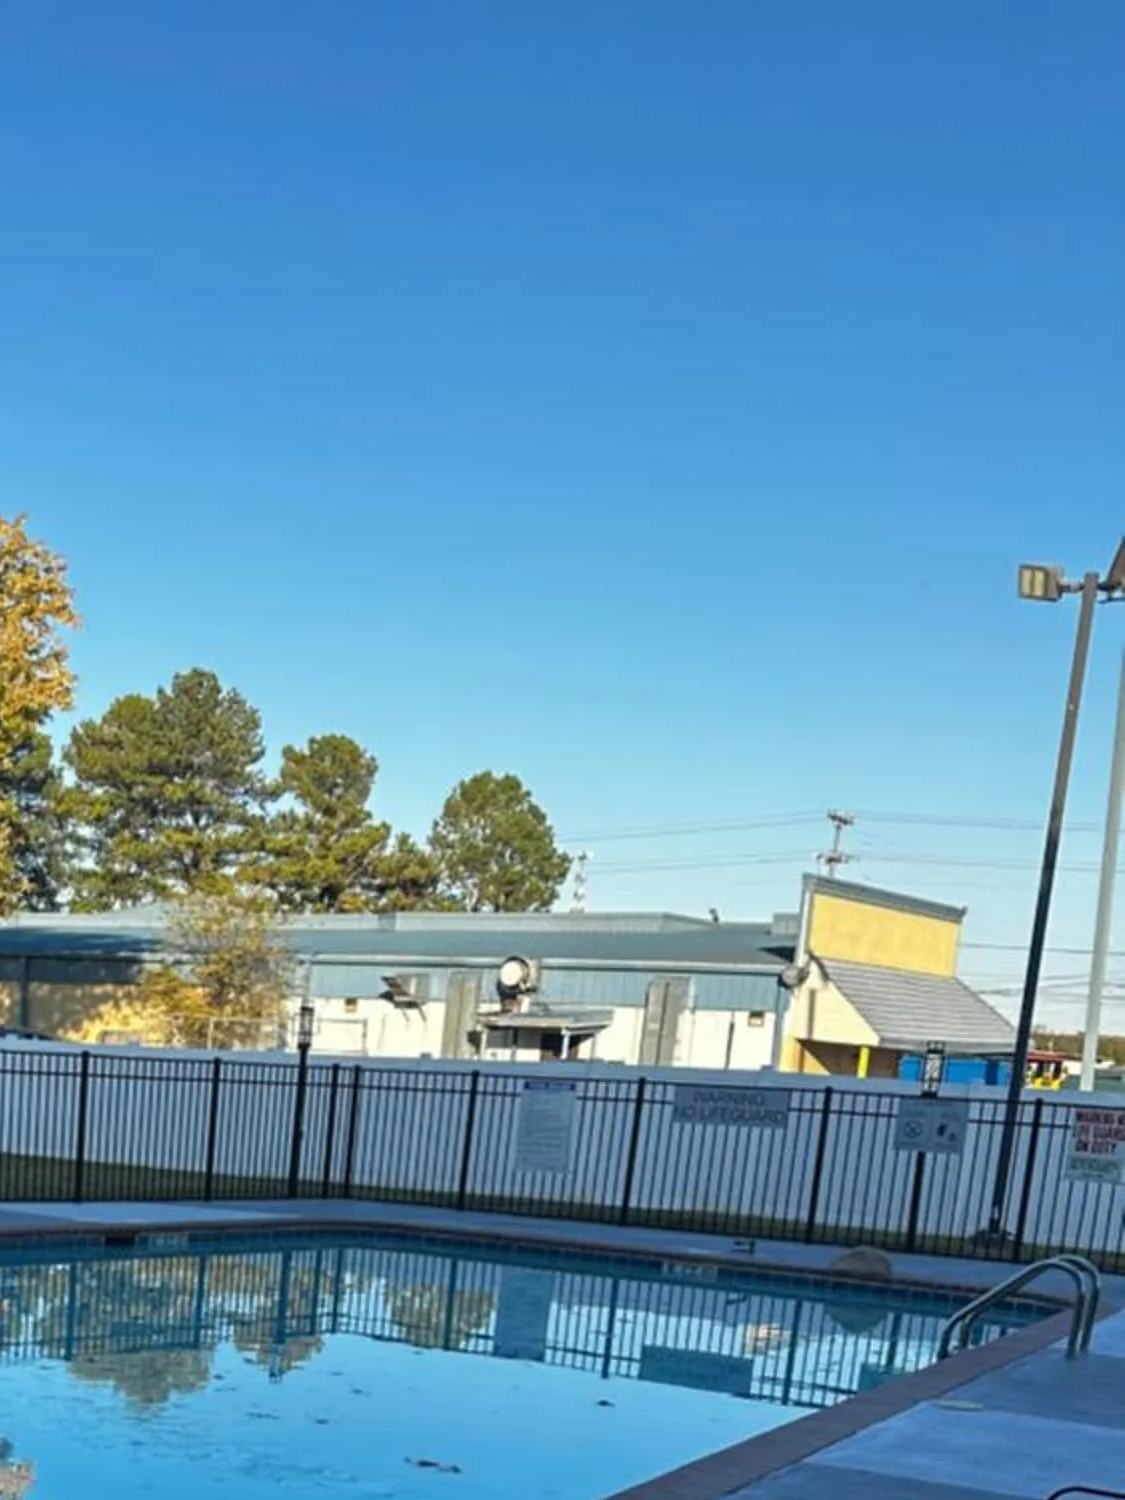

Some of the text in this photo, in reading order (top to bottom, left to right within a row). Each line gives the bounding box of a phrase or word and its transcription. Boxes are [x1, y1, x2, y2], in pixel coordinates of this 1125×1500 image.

[694, 1090, 763, 1106] WARNING
[673, 1106, 787, 1125] NO LIFEGUARD
[1075, 1139, 1116, 1154] ON DUTY
